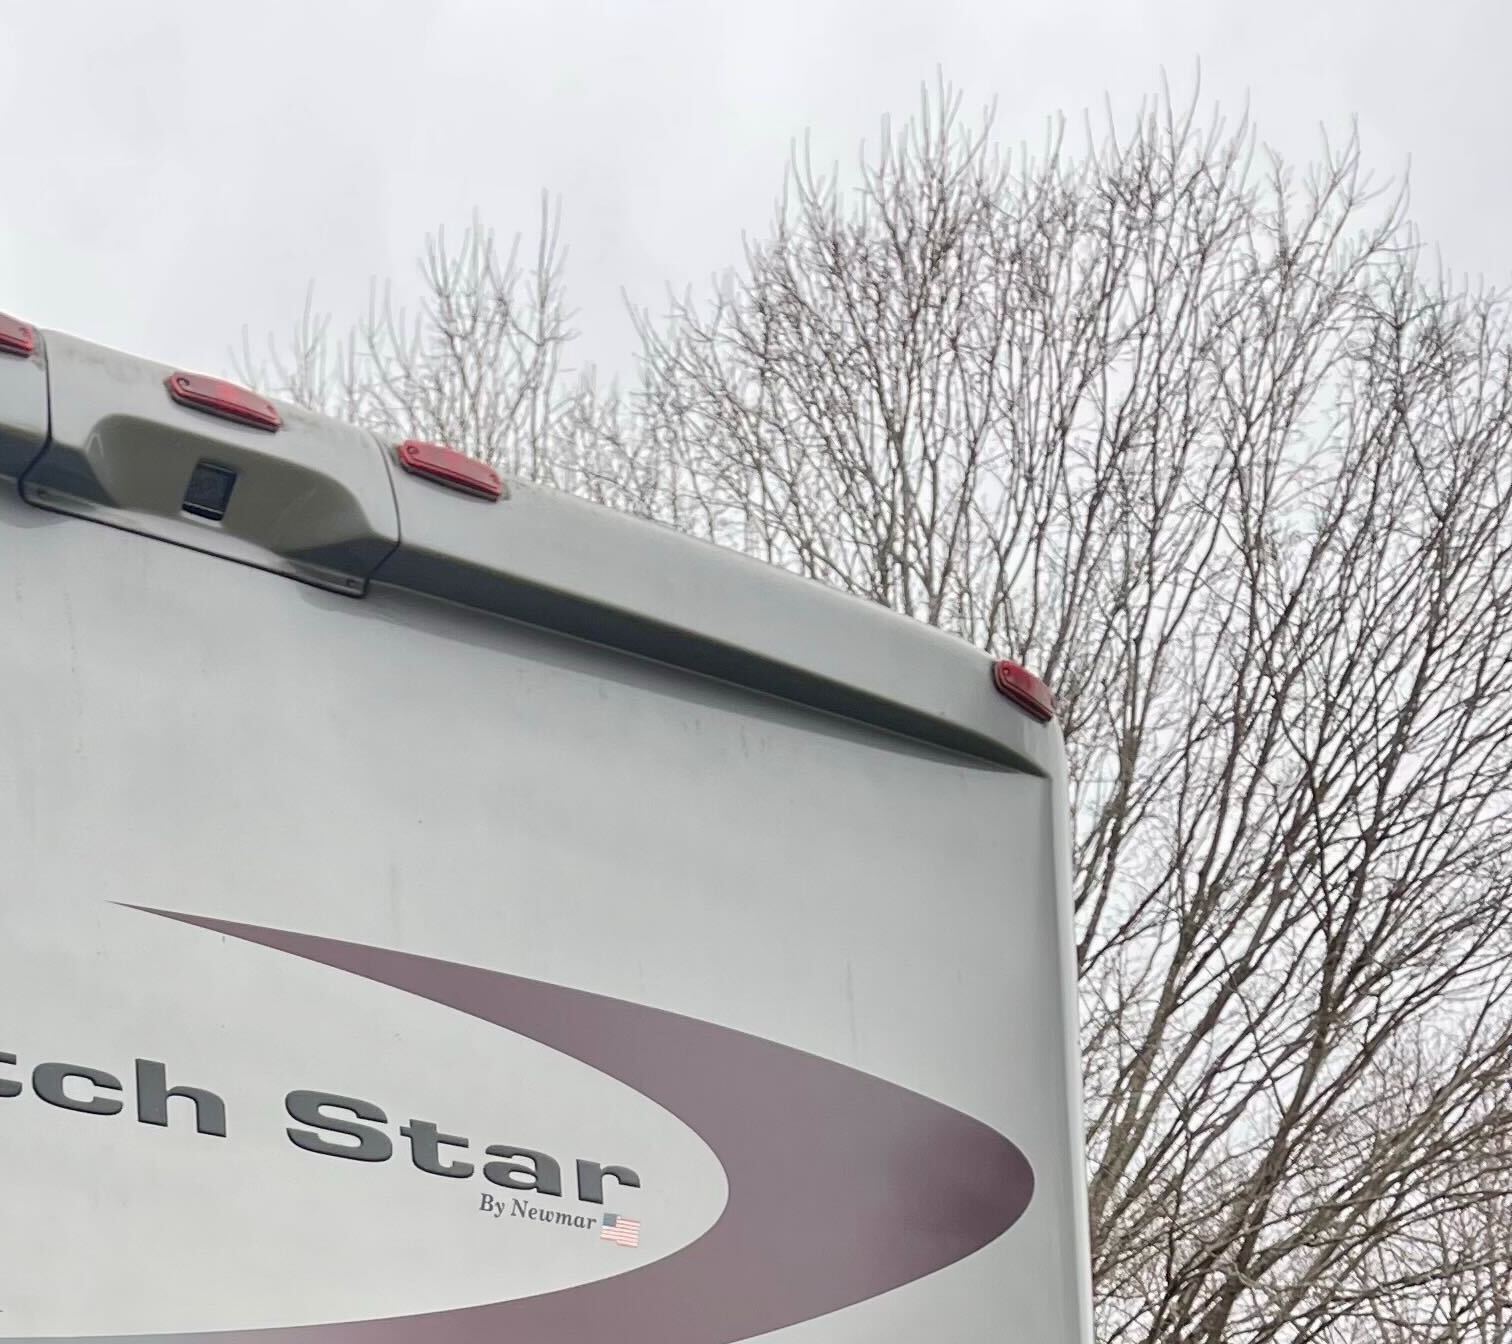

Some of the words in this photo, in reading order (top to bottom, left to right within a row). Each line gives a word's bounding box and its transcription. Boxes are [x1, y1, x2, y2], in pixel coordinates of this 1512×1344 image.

[283, 1088, 641, 1205] Star
[479, 1192, 506, 1218] By
[510, 1198, 597, 1230] Newmar
